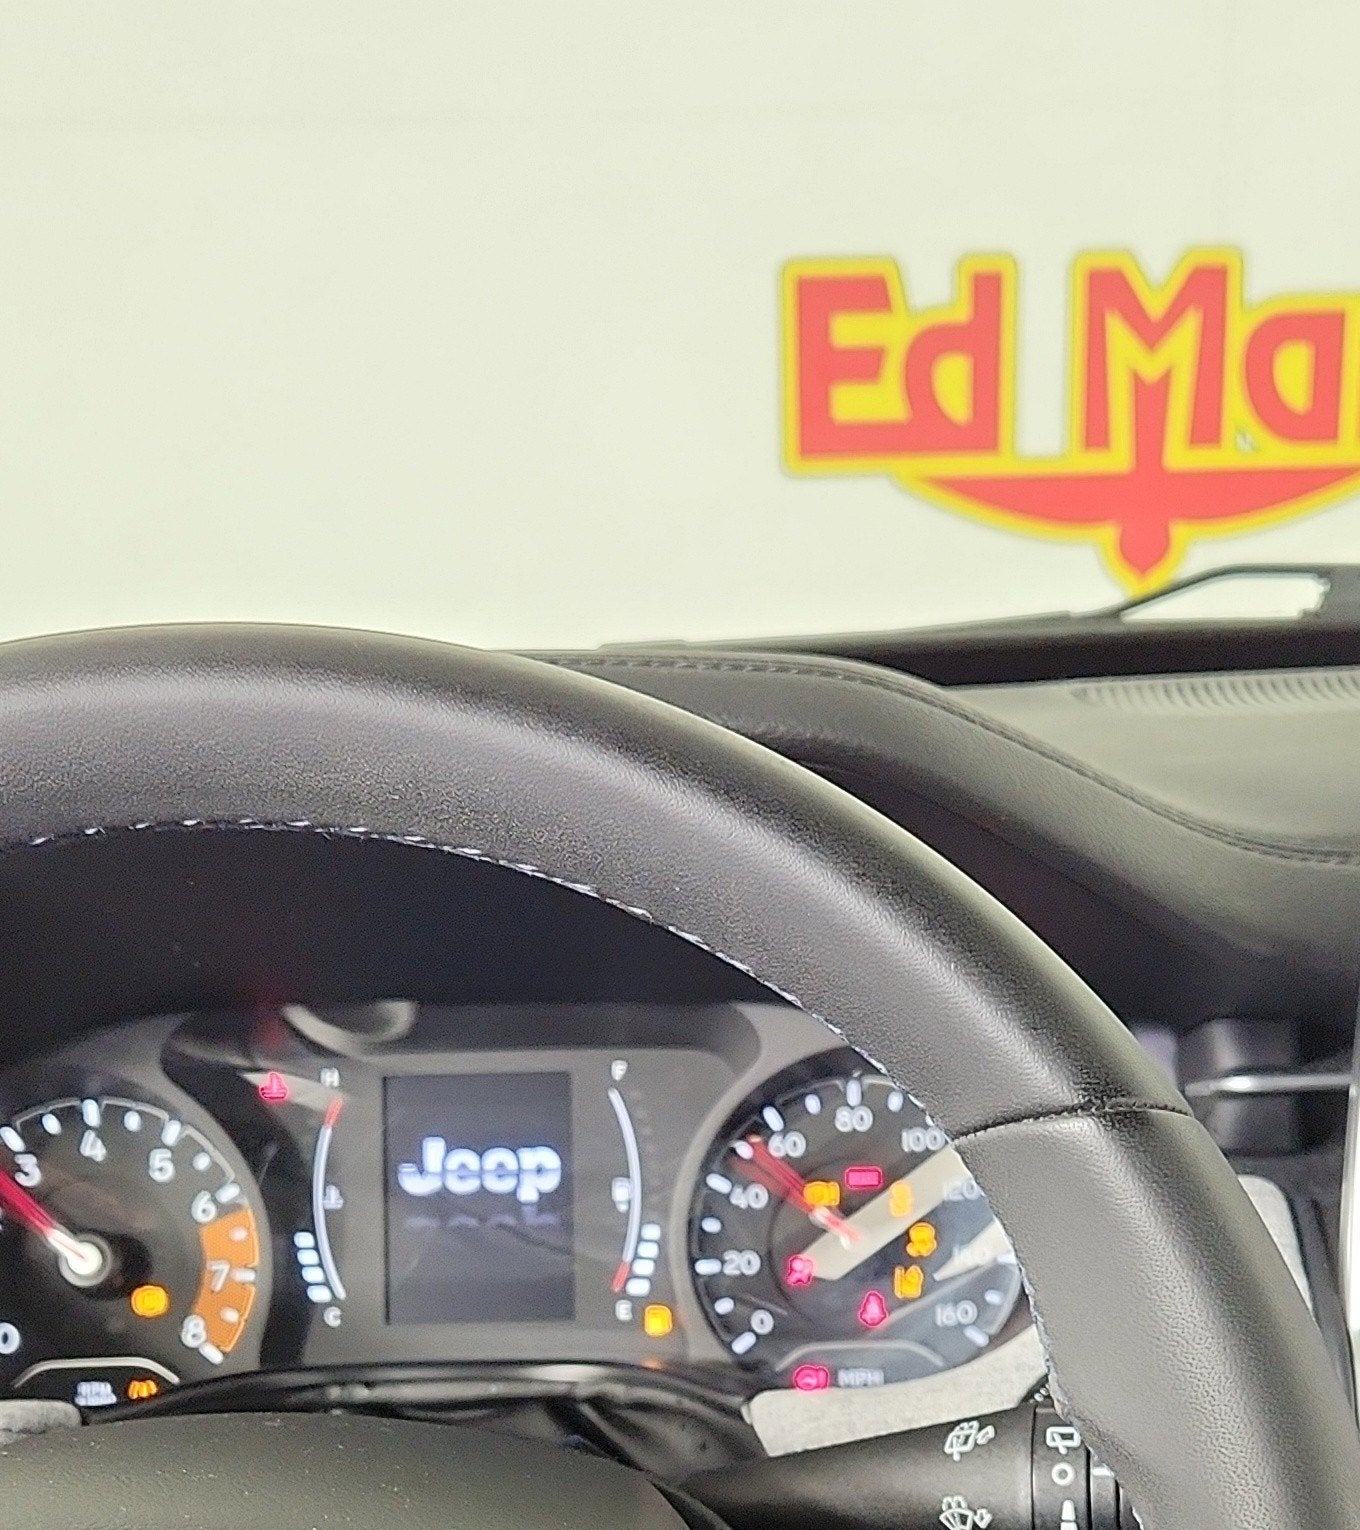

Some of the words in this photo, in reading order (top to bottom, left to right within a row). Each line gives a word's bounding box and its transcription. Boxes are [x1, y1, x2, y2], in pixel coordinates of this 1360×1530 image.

[790, 263, 1010, 463] Ed
[835, 1105, 873, 1132] 80
[80, 1130, 106, 1161] 4
[768, 1130, 807, 1158] 60
[901, 1127, 945, 1152] 100
[14, 1153, 41, 1187] 3
[148, 1148, 175, 1182] 5
[398, 1136, 561, 1203] Jeep
[191, 1190, 217, 1224] 6
[729, 1183, 769, 1209] 40
[207, 1260, 230, 1292] 7
[722, 1249, 761, 1276] 20
[750, 1309, 774, 1335] 0
[935, 1299, 978, 1327] 160
[181, 1315, 207, 1348] 8
[838, 1368, 885, 1387] MPH
